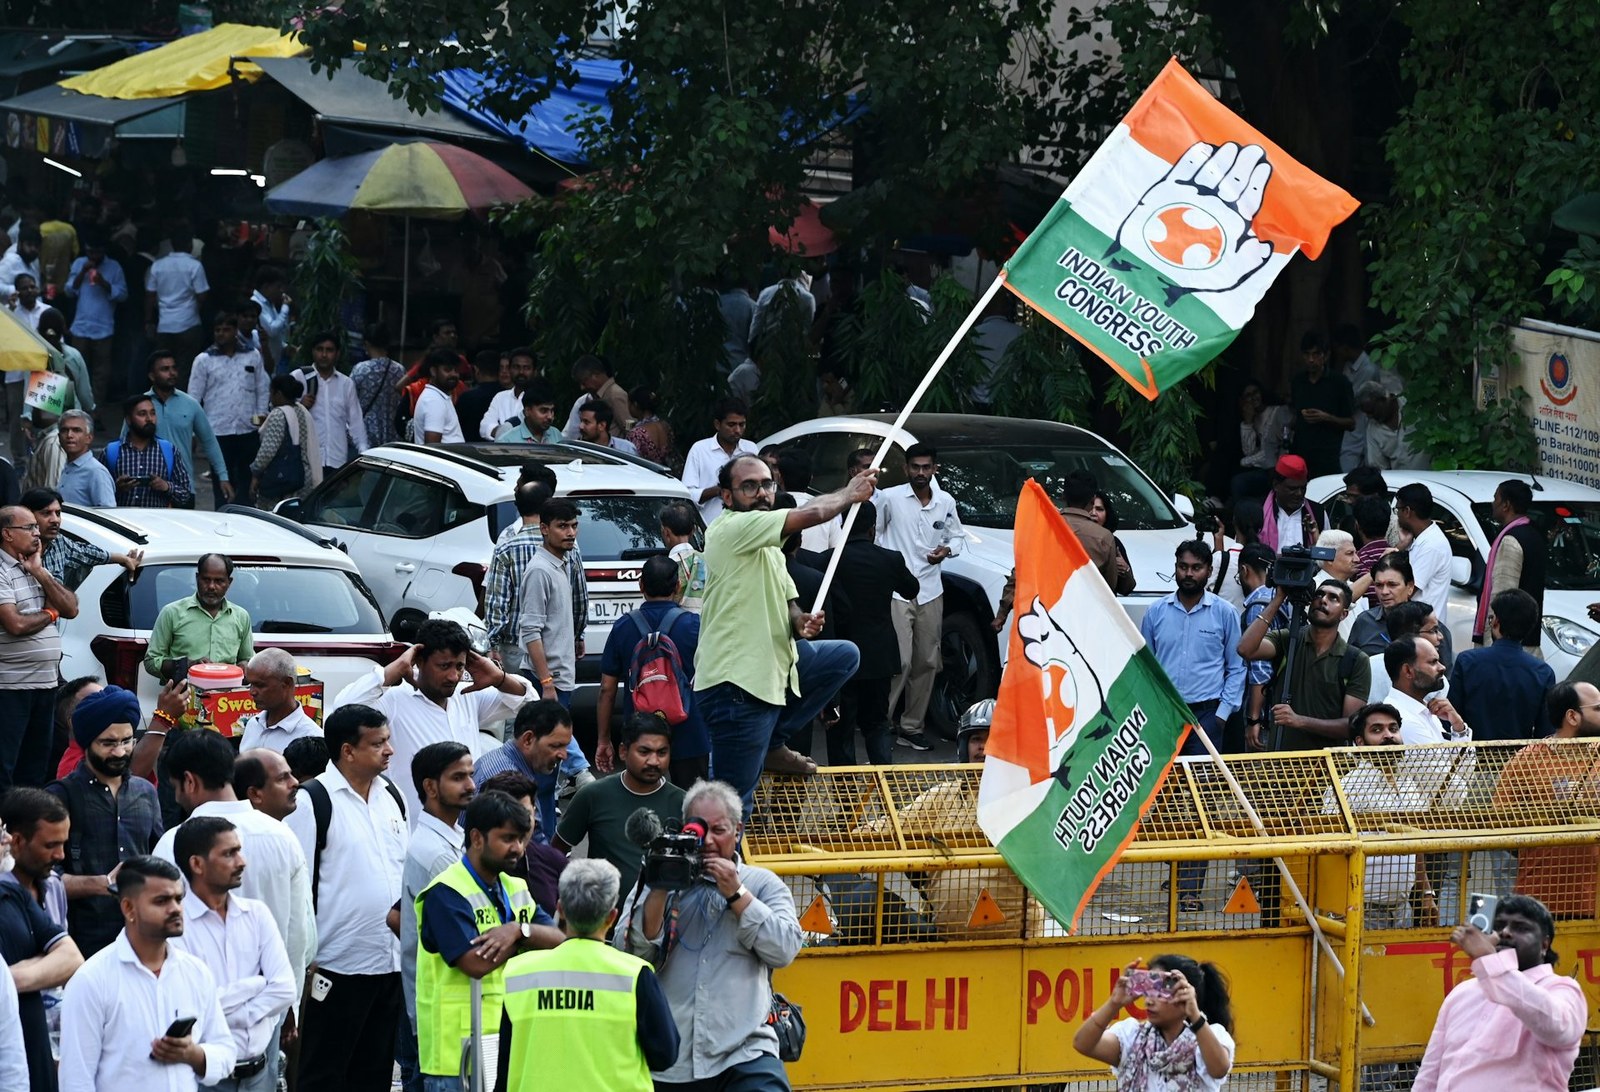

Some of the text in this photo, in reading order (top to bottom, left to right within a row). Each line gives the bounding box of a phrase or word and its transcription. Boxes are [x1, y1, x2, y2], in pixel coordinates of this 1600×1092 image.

[1059, 248, 1197, 349] INDIAN YOUTH
[1056, 279, 1163, 359] CONGRESS
[1530, 417, 1600, 444] PLINE-112/109
[1540, 450, 1600, 475] Delhi-110001
[594, 603, 610, 617] DL
[538, 989, 594, 1011] MEDIA
[839, 976, 969, 1033] DELHI
